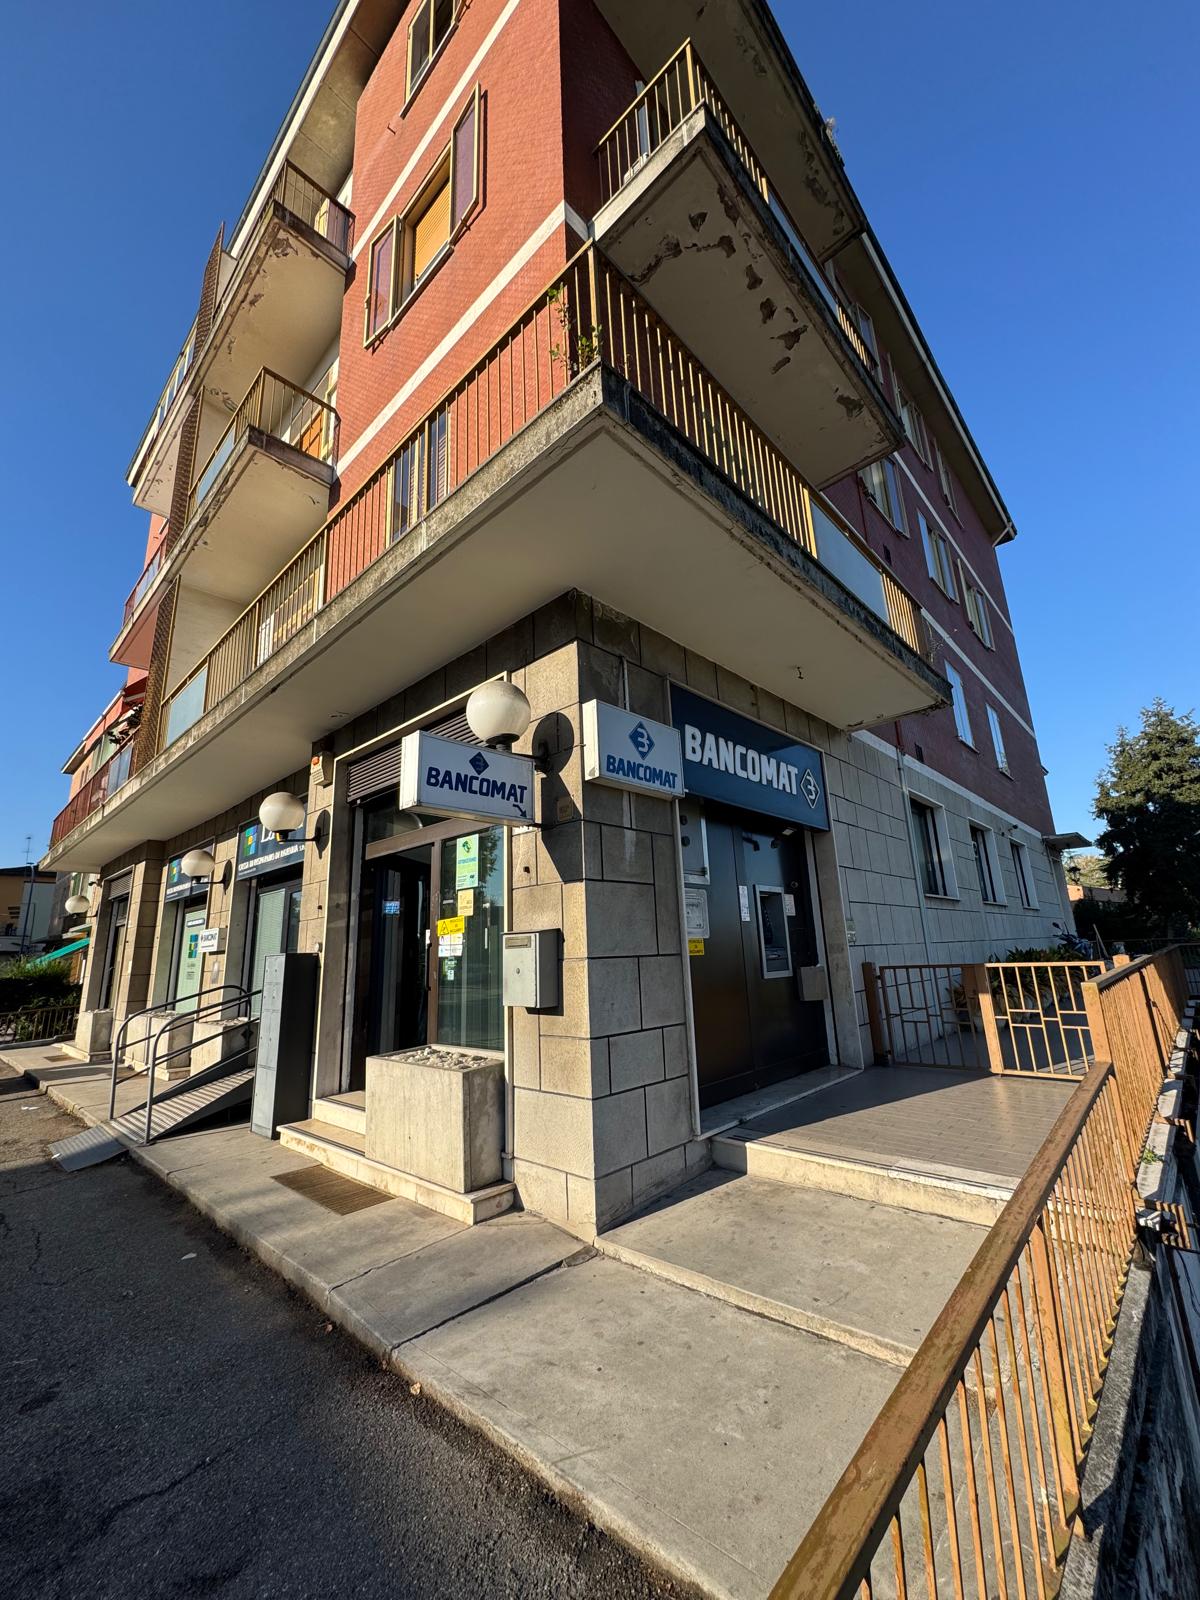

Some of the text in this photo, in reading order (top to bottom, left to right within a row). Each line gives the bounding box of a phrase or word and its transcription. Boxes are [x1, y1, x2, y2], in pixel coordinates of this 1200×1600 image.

[606, 754, 678, 790] BANCOMAT
[684, 723, 799, 796] BANCOMAT
[426, 766, 528, 804] BANCOMAT
